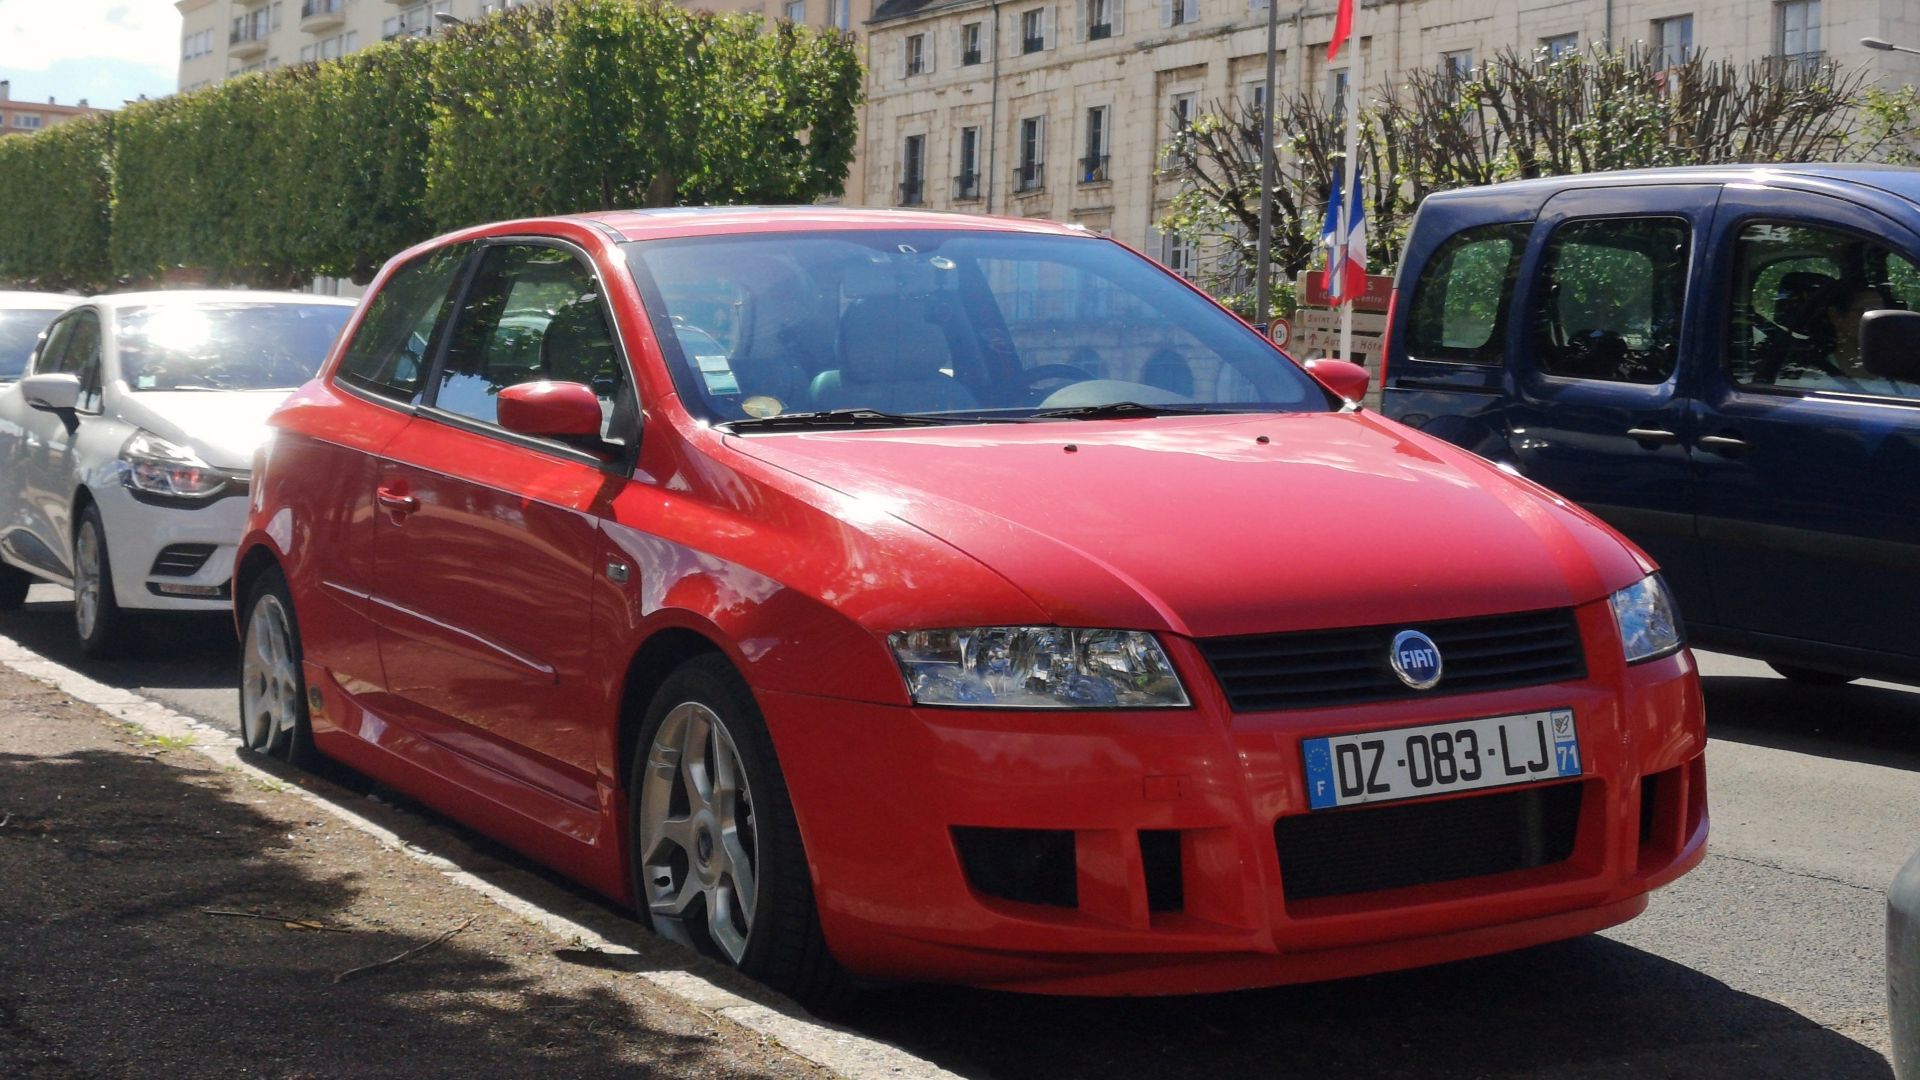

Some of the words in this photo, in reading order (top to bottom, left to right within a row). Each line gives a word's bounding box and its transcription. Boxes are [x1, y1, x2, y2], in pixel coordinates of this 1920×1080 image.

[1323, 336, 1356, 348] Auts
[1400, 648, 1434, 670] FIAT
[1335, 720, 1550, 798] DZ-083-LJ
[1557, 744, 1579, 771] 71
[1316, 780, 1326, 797] F
